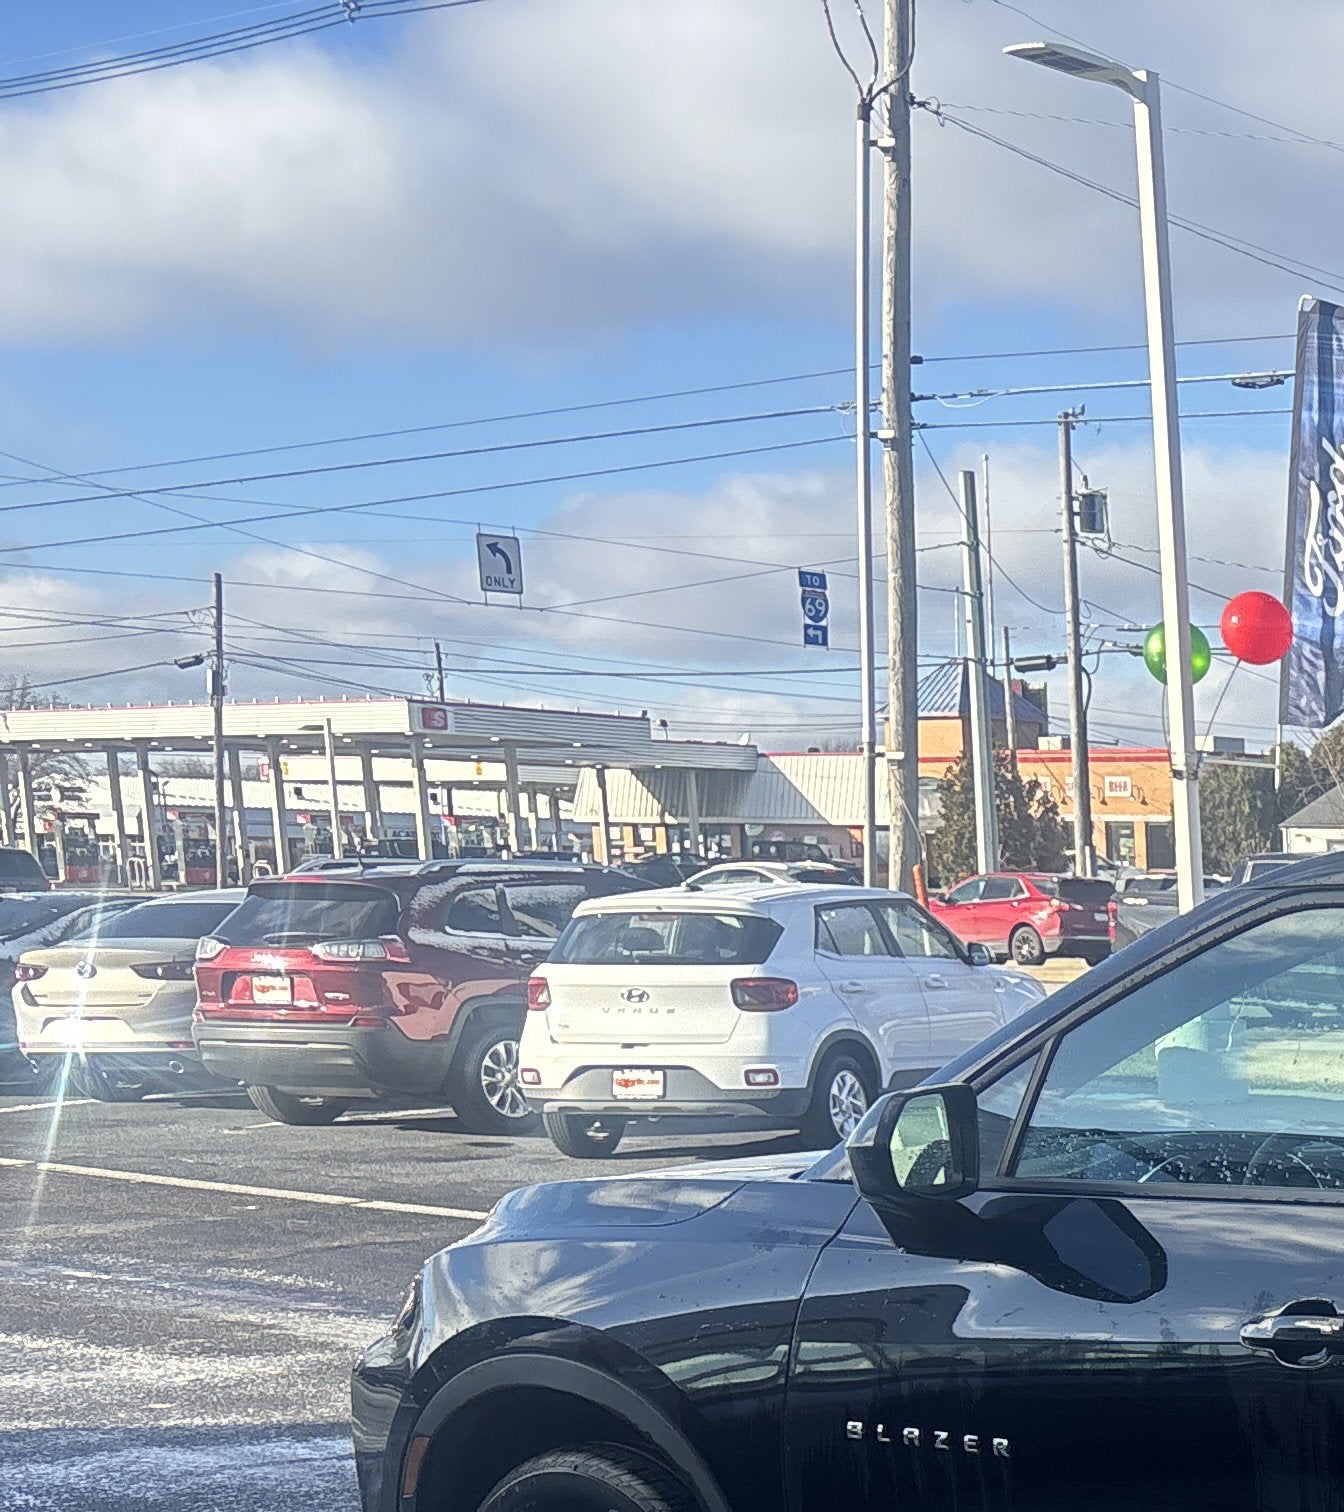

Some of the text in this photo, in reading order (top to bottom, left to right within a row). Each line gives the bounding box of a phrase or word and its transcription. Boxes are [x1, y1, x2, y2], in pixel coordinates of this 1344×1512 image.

[485, 575, 516, 588] ONLY
[806, 575, 820, 586] TO
[805, 598, 826, 617] 69
[846, 1420, 1010, 1458] BLAZER
